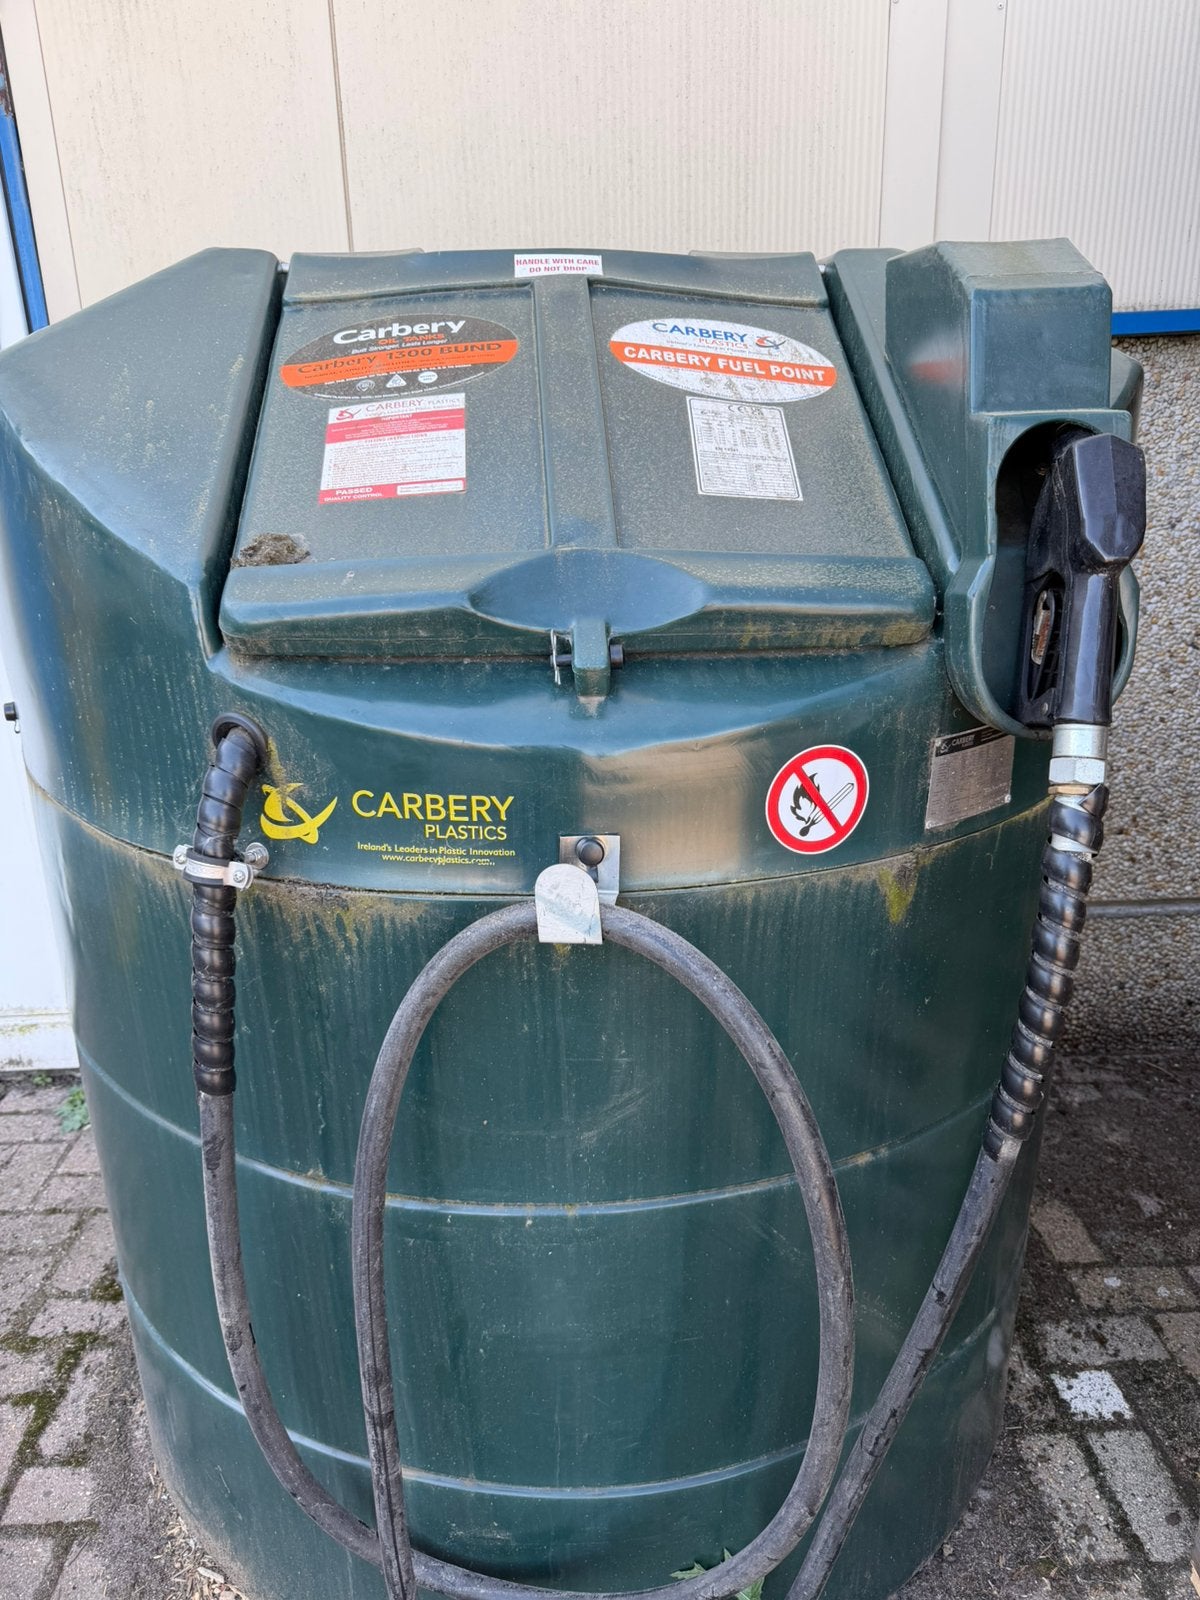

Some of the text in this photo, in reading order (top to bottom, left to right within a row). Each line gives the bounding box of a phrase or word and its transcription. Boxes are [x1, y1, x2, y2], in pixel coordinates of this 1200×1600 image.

[516, 258, 551, 266] HANDLE
[576, 258, 600, 266] CARE
[333, 320, 466, 344] Carbery
[401, 333, 445, 342] TANKS
[652, 322, 747, 343] CARBERY
[421, 337, 448, 347] Longer
[698, 338, 748, 349] PLASTICS
[297, 355, 377, 374] Carbery
[386, 344, 432, 360] 1300
[439, 342, 502, 356] BUND
[624, 346, 824, 382] CARBERY FUEL POINT
[366, 398, 424, 412] CARBERY
[324, 492, 383, 503] QUALITY CONTROL
[336, 487, 373, 496] PASSED
[351, 789, 515, 823] CARBERY
[424, 824, 507, 841] PLASTICS
[357, 841, 516, 857] Ireland's Leaders in Plastic Innovation
